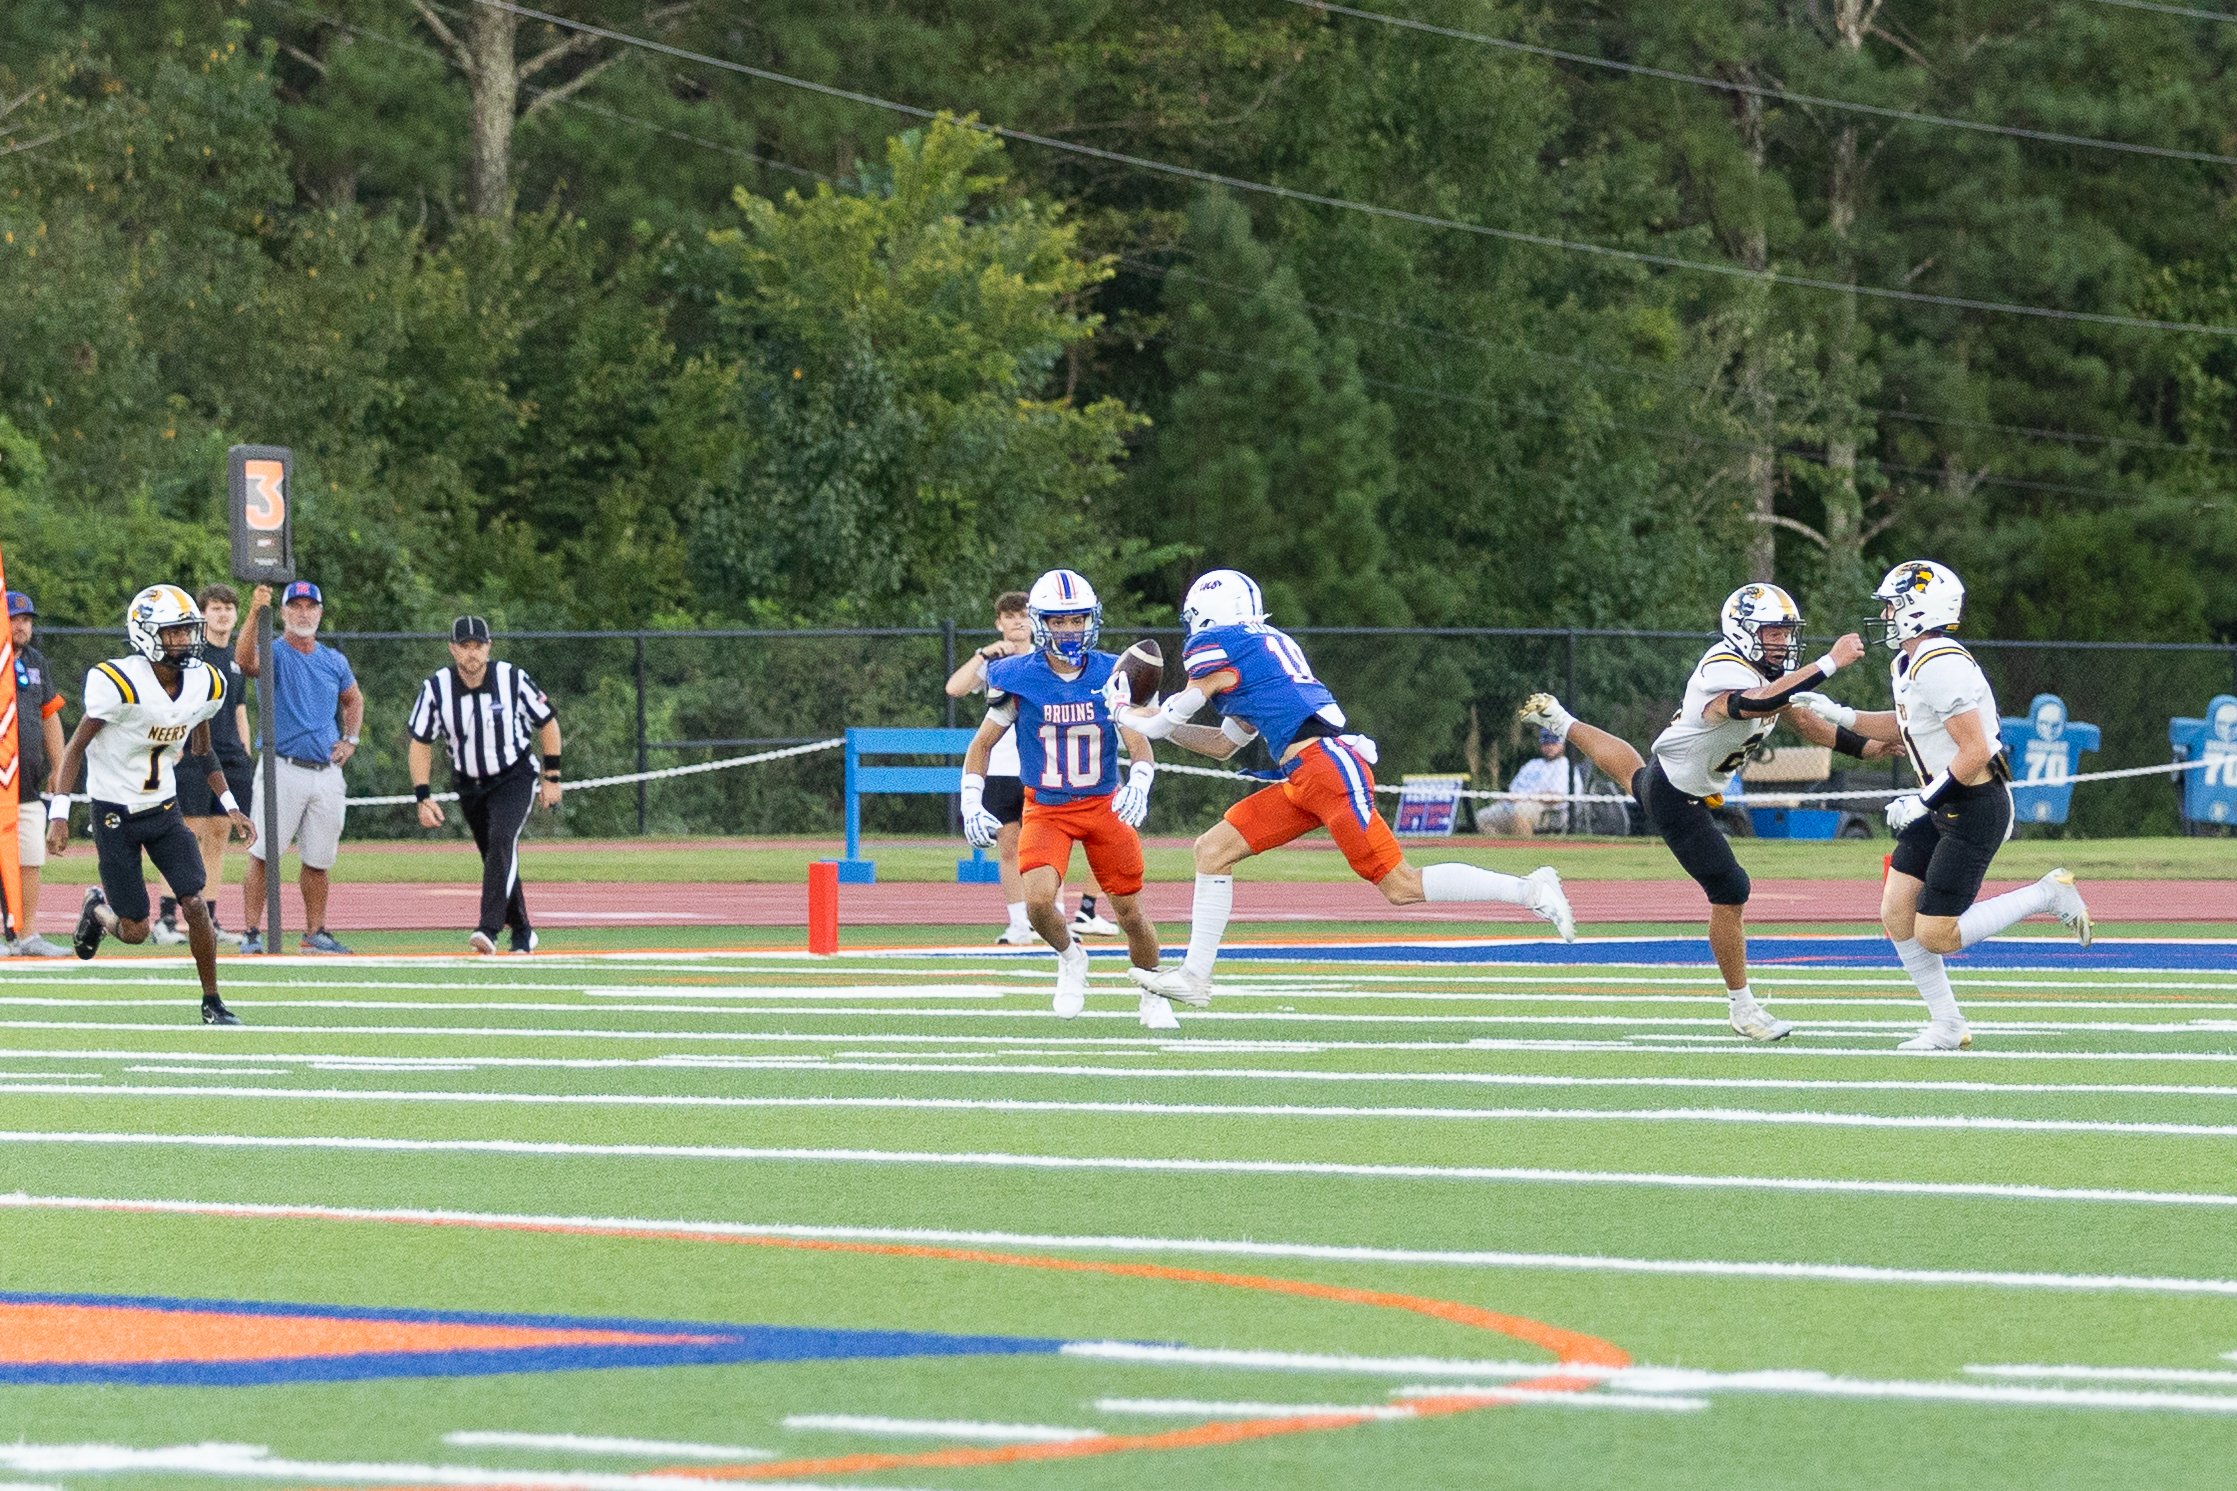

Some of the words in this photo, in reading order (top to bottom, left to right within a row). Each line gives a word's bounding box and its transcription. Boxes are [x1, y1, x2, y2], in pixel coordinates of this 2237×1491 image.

[245, 460, 285, 530] 3
[148, 725, 187, 742] NEERS
[1044, 702, 1094, 724] BRUINS
[143, 744, 169, 794] 1
[1040, 724, 1102, 788] 10
[2024, 752, 2068, 787] 70
